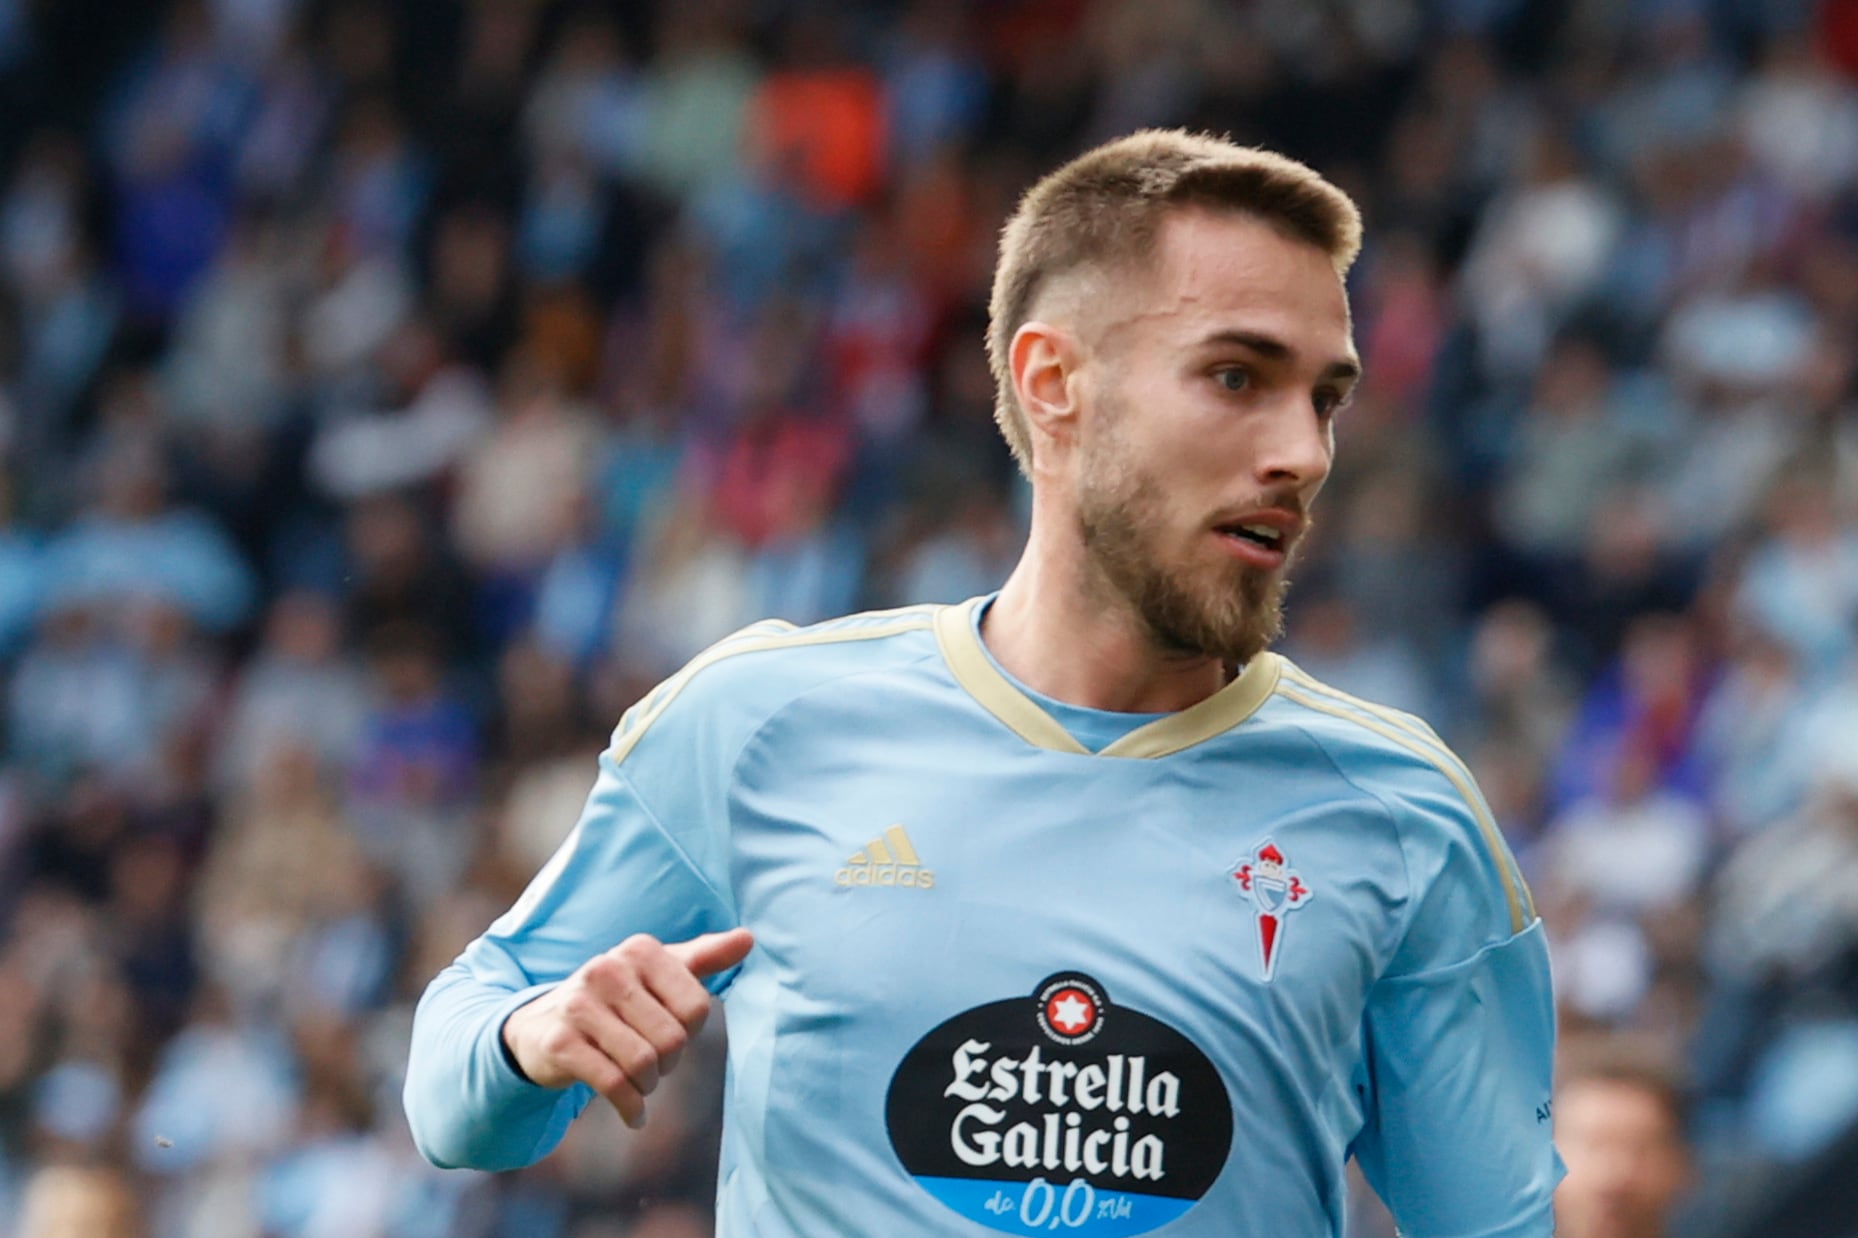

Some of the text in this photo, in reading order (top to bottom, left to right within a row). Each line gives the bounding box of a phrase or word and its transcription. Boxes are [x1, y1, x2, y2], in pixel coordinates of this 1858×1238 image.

[834, 863, 936, 889] adidas
[944, 1039, 1181, 1118] Estrella
[951, 1103, 1166, 1182] Galicia
[1020, 1177, 1096, 1230] 0,0
